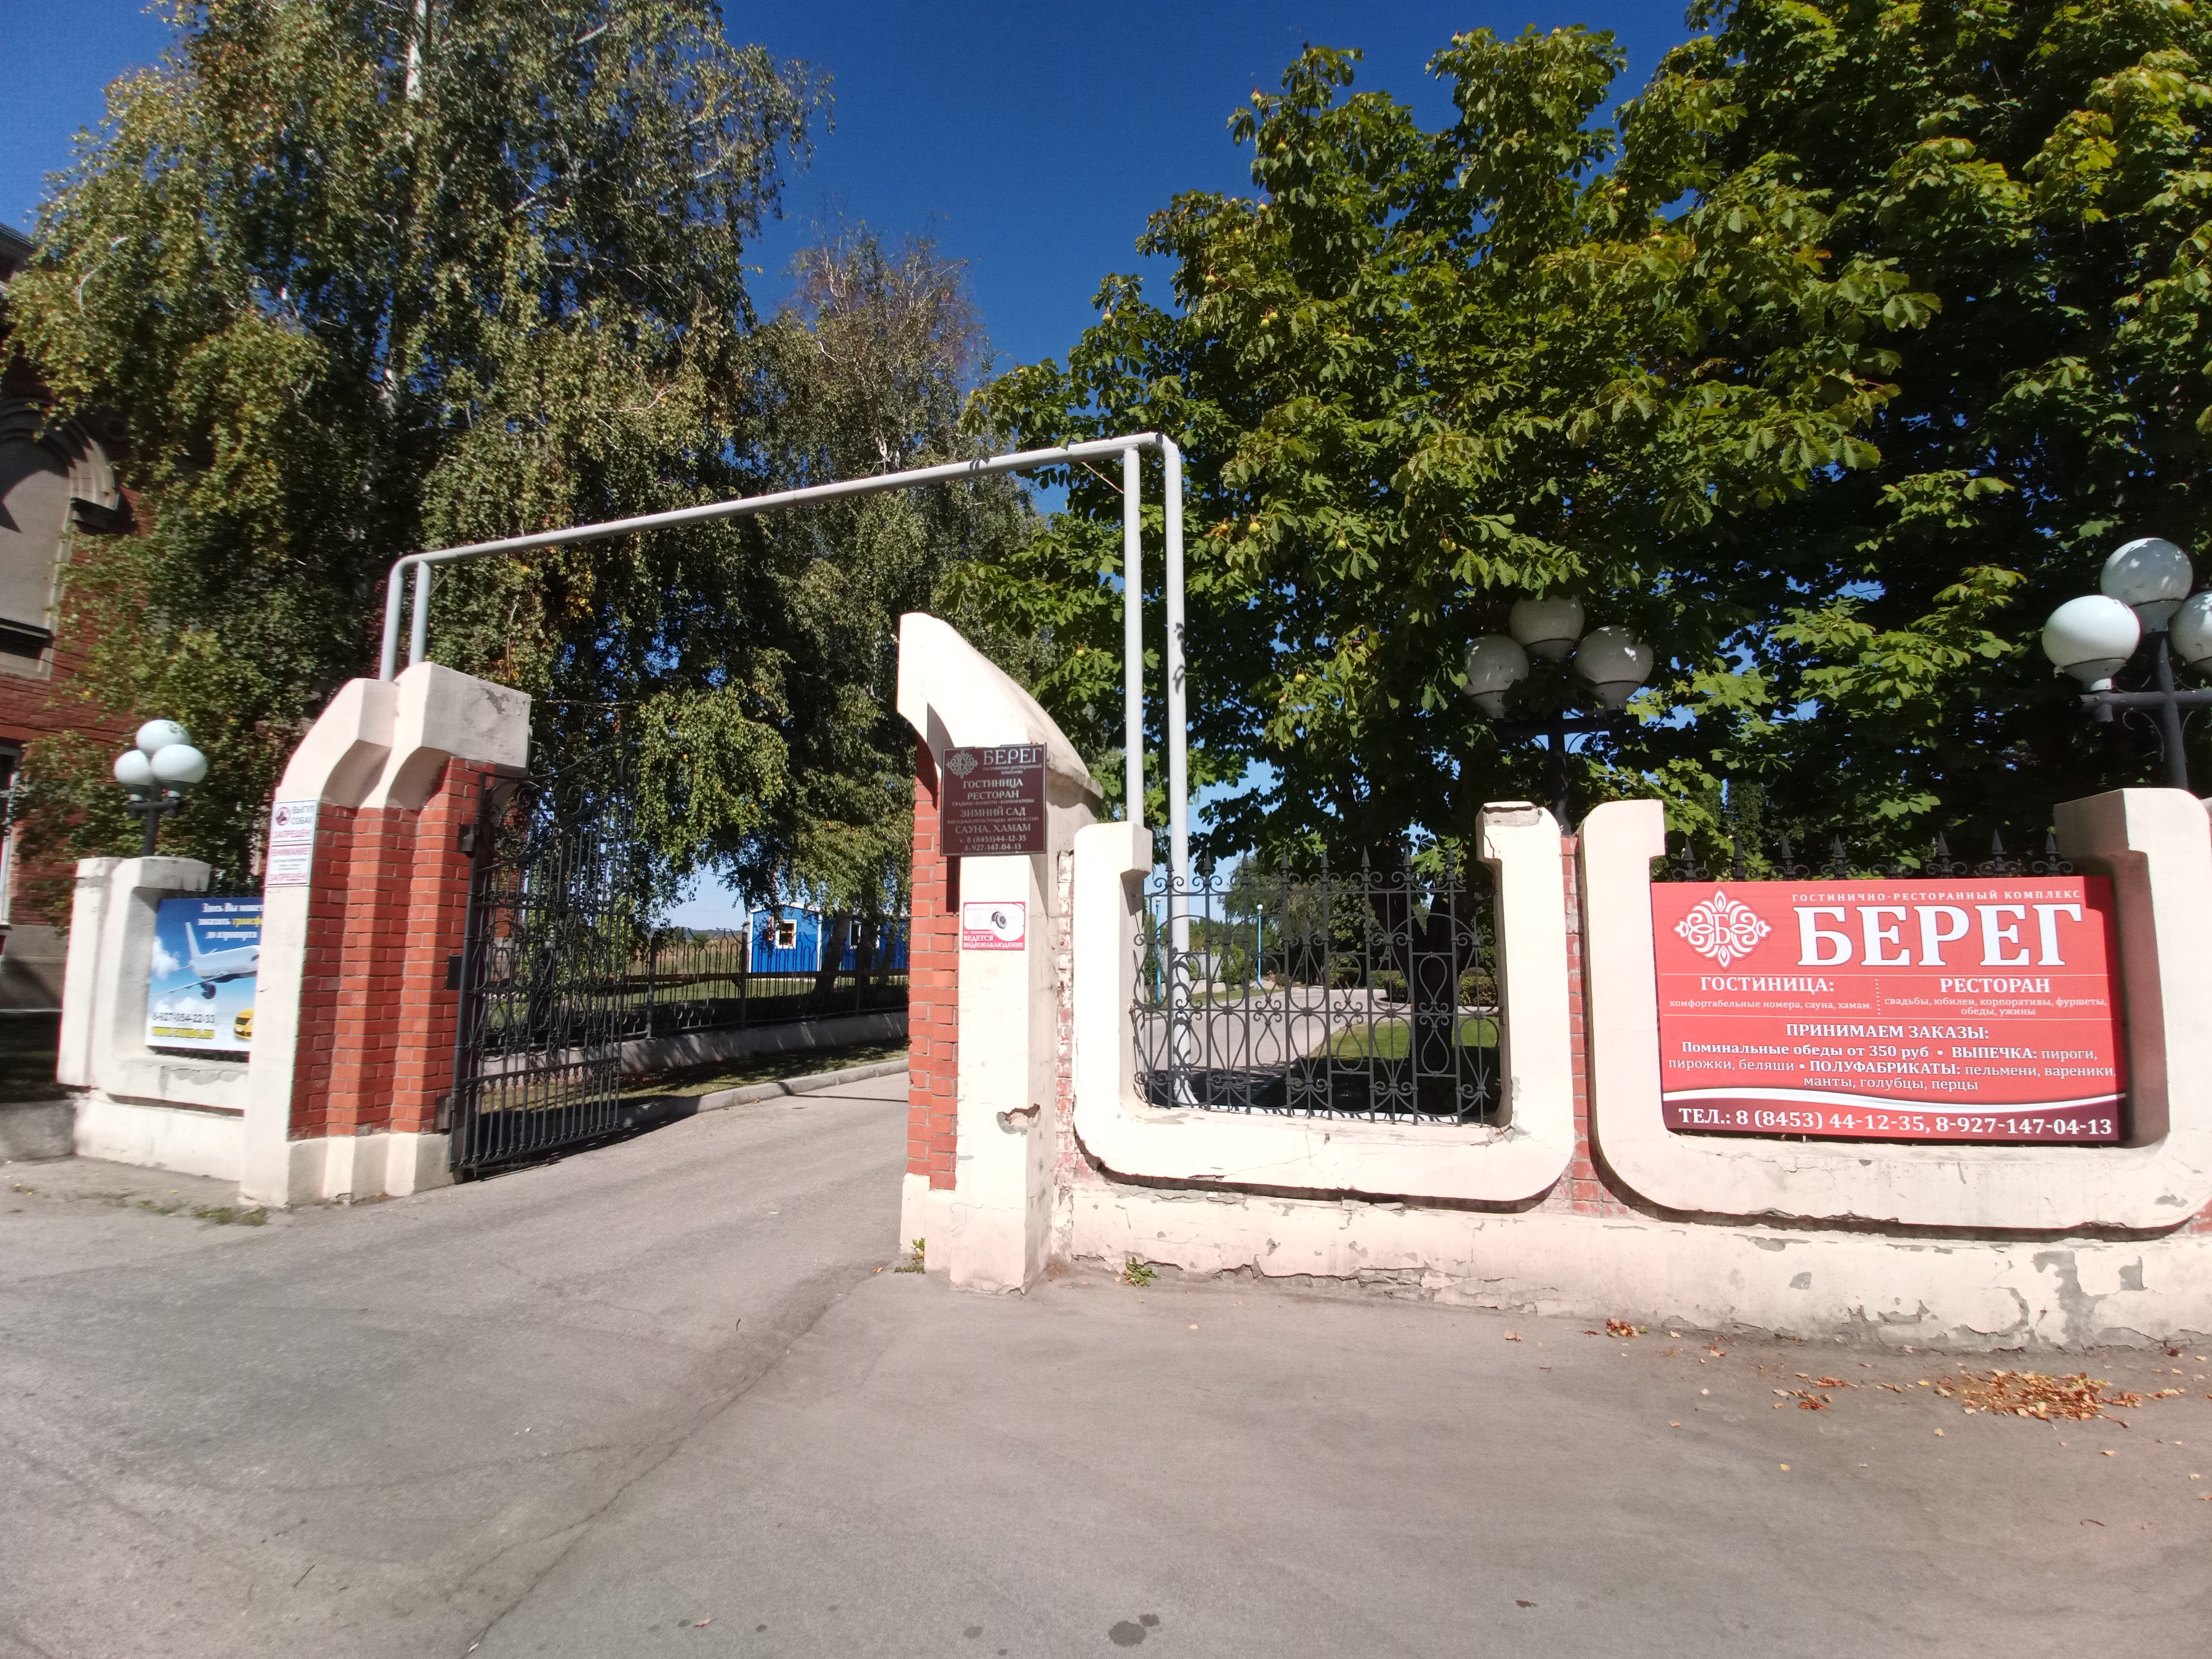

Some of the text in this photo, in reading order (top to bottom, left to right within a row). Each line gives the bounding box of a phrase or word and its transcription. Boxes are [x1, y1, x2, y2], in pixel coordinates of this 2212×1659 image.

[984, 747, 1042, 765] БЕРЕГ
[963, 778, 1023, 789] ГОСТИНИЦА
[967, 790, 1019, 800] РЕСТОРАН
[961, 805, 1026, 817] ЗИМНИЙ САД
[955, 823, 1031, 834] САУНА, ХАМАМ
[964, 843, 1022, 852] 8-927-147-04-13
[1792, 890, 2080, 902] ГОСТИНИЧНО-РЕСТОРАННЫЙ КОМПЛЕКС
[1793, 903, 2082, 967] БЕРЕГ
[1700, 976, 1834, 994] ГОСТИНИЦА:
[1940, 978, 2051, 993] РЕСТОРАН
[1670, 999, 1760, 1009] комфортабельные
[1763, 1001, 1803, 1011] номера,
[1805, 1002, 1836, 1011] сауна,
[1885, 997, 2107, 1008] свадьбы, юбилеи, корпоративы, фуршеты,
[153, 1012, 215, 1023] 8-927-054-22-33
[1961, 1009, 1997, 1017] обеды,
[1786, 1023, 1989, 1039] ПРИНИМАЕМ ЗАКАЗЫ:
[1682, 1041, 2097, 1062] Поминальные обеды от 350 руб ВЫПЕЧКА: пироги,
[1669, 1058, 2116, 1079] пирожки, беляши ПОЛУФАБРИКАТЫ: пельмени, вареники,
[1803, 1077, 1978, 1092] манты, голубцы, перцы
[1679, 1108, 2111, 1134] ТЕЛ.: 8 (8453) 44-12-35, 8-927-147-04-13
